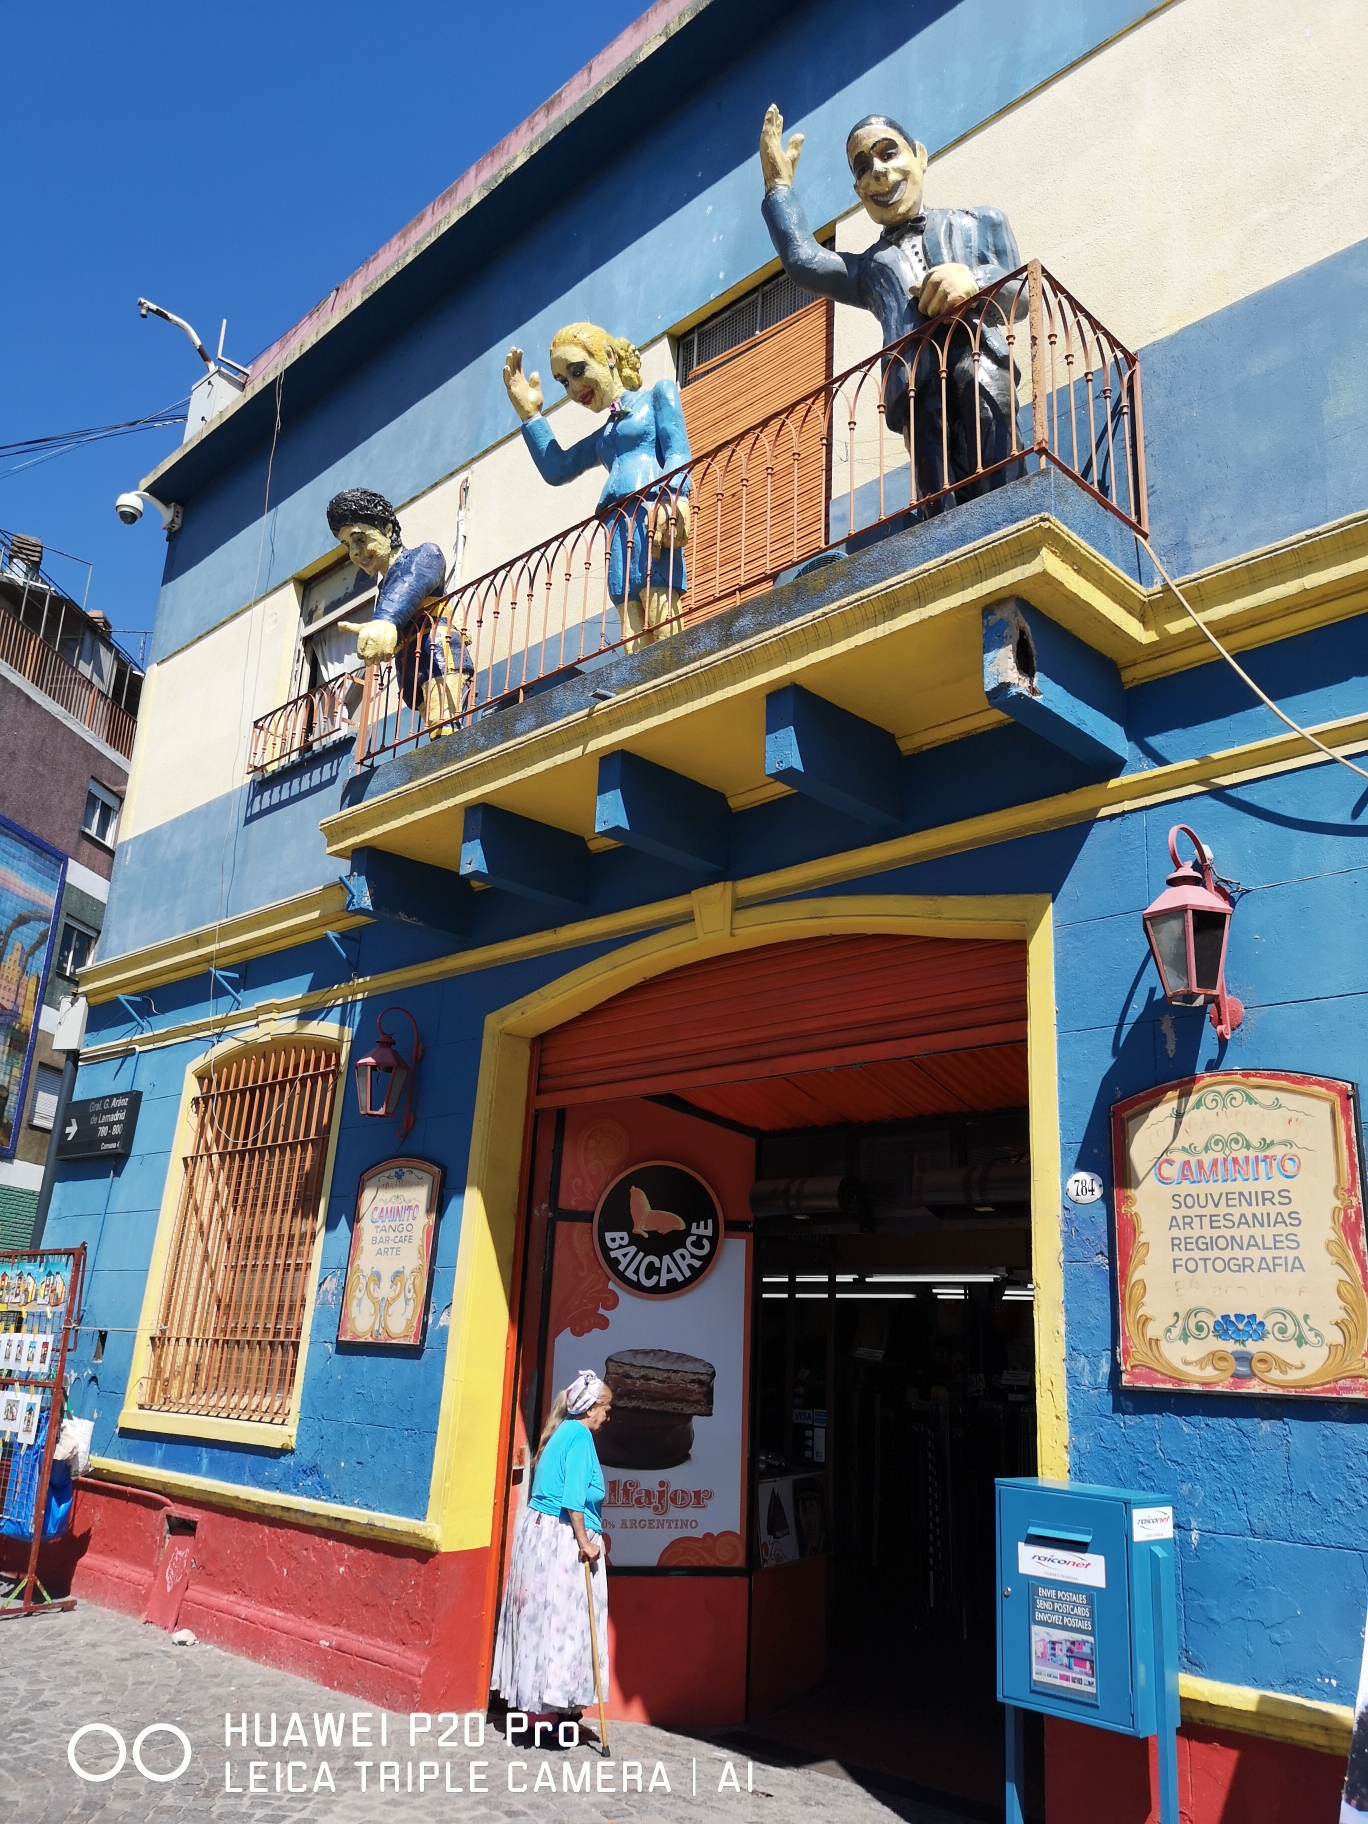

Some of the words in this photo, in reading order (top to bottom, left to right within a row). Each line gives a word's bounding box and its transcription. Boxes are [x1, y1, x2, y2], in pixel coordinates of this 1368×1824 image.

[90, 1114, 98, 1124] de
[1154, 1152, 1302, 1186] CAMINITO
[1074, 1178, 1095, 1196] 784
[1172, 1188, 1292, 1210] SOUVENIRS
[370, 1204, 419, 1224] CAMINITO
[1168, 1210, 1302, 1231] ARTESANIAS
[374, 1223, 413, 1233] TANGO
[375, 1247, 401, 1256] ARTE
[1170, 1233, 1301, 1252] REGIONALES
[604, 1218, 712, 1288] BALCARCE
[1172, 1256, 1306, 1274] FOTOGRAFIA
[795, 1412, 811, 1420] VISA
[601, 1478, 715, 1516] lfajor
[620, 1519, 699, 1529] ARGENTINO
[1138, 1515, 1170, 1525] raiconet
[1031, 1554, 1091, 1569] raiconet
[1038, 1586, 1056, 1599] ENVIE
[1058, 1589, 1086, 1604] POSTALES
[1036, 1599, 1053, 1610] SEND
[1054, 1602, 1090, 1617] POSTCARDS
[1035, 1611, 1062, 1626] ENVOYEZ
[1064, 1616, 1092, 1631] POSTALES
